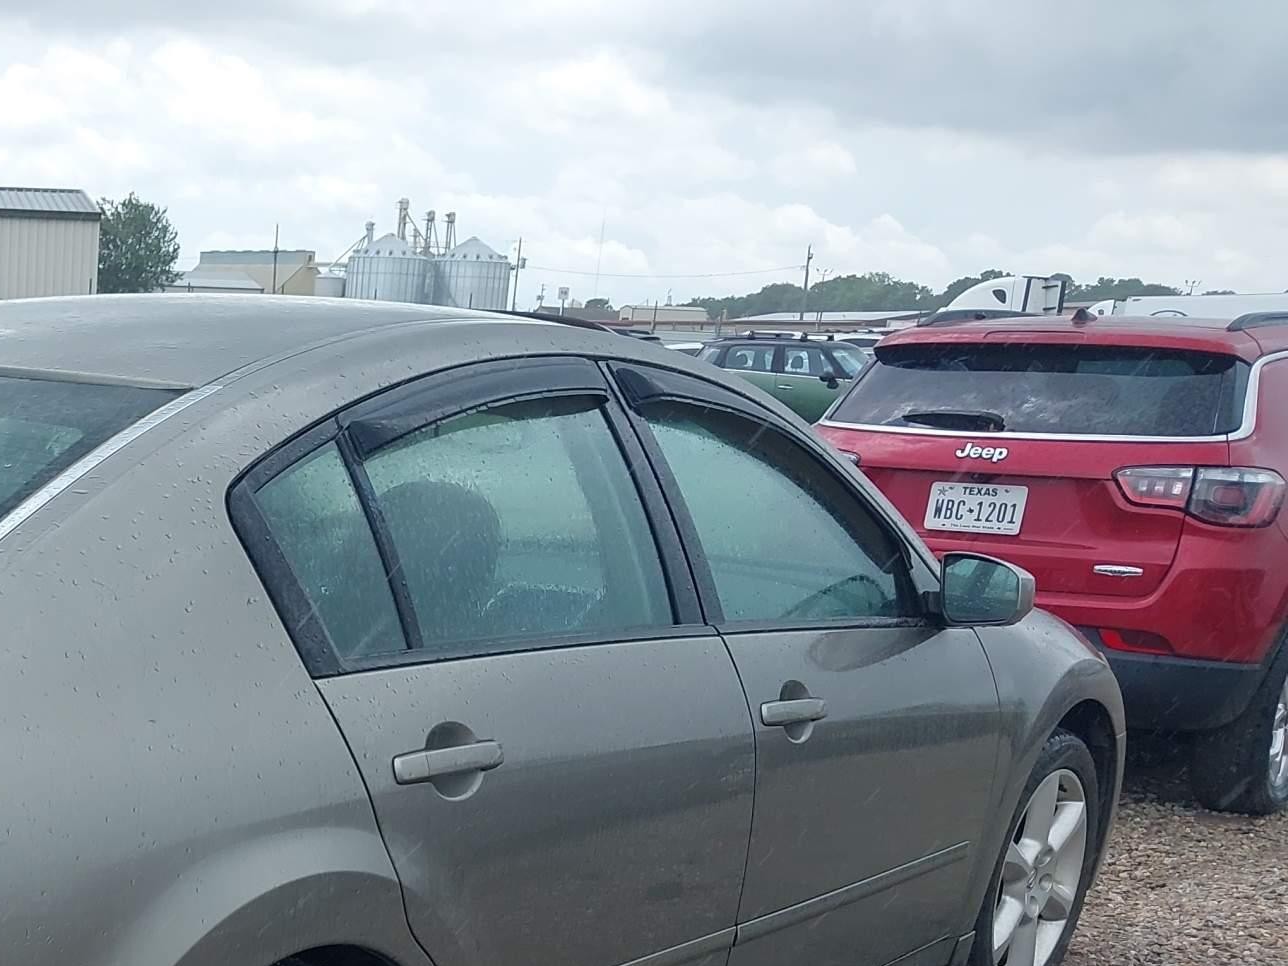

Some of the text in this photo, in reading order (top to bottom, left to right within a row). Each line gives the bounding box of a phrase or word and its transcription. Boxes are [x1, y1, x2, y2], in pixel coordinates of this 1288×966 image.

[955, 442, 1008, 463] Jeep
[962, 485, 999, 497] TEXAS
[933, 498, 1017, 525] WBC 1201
